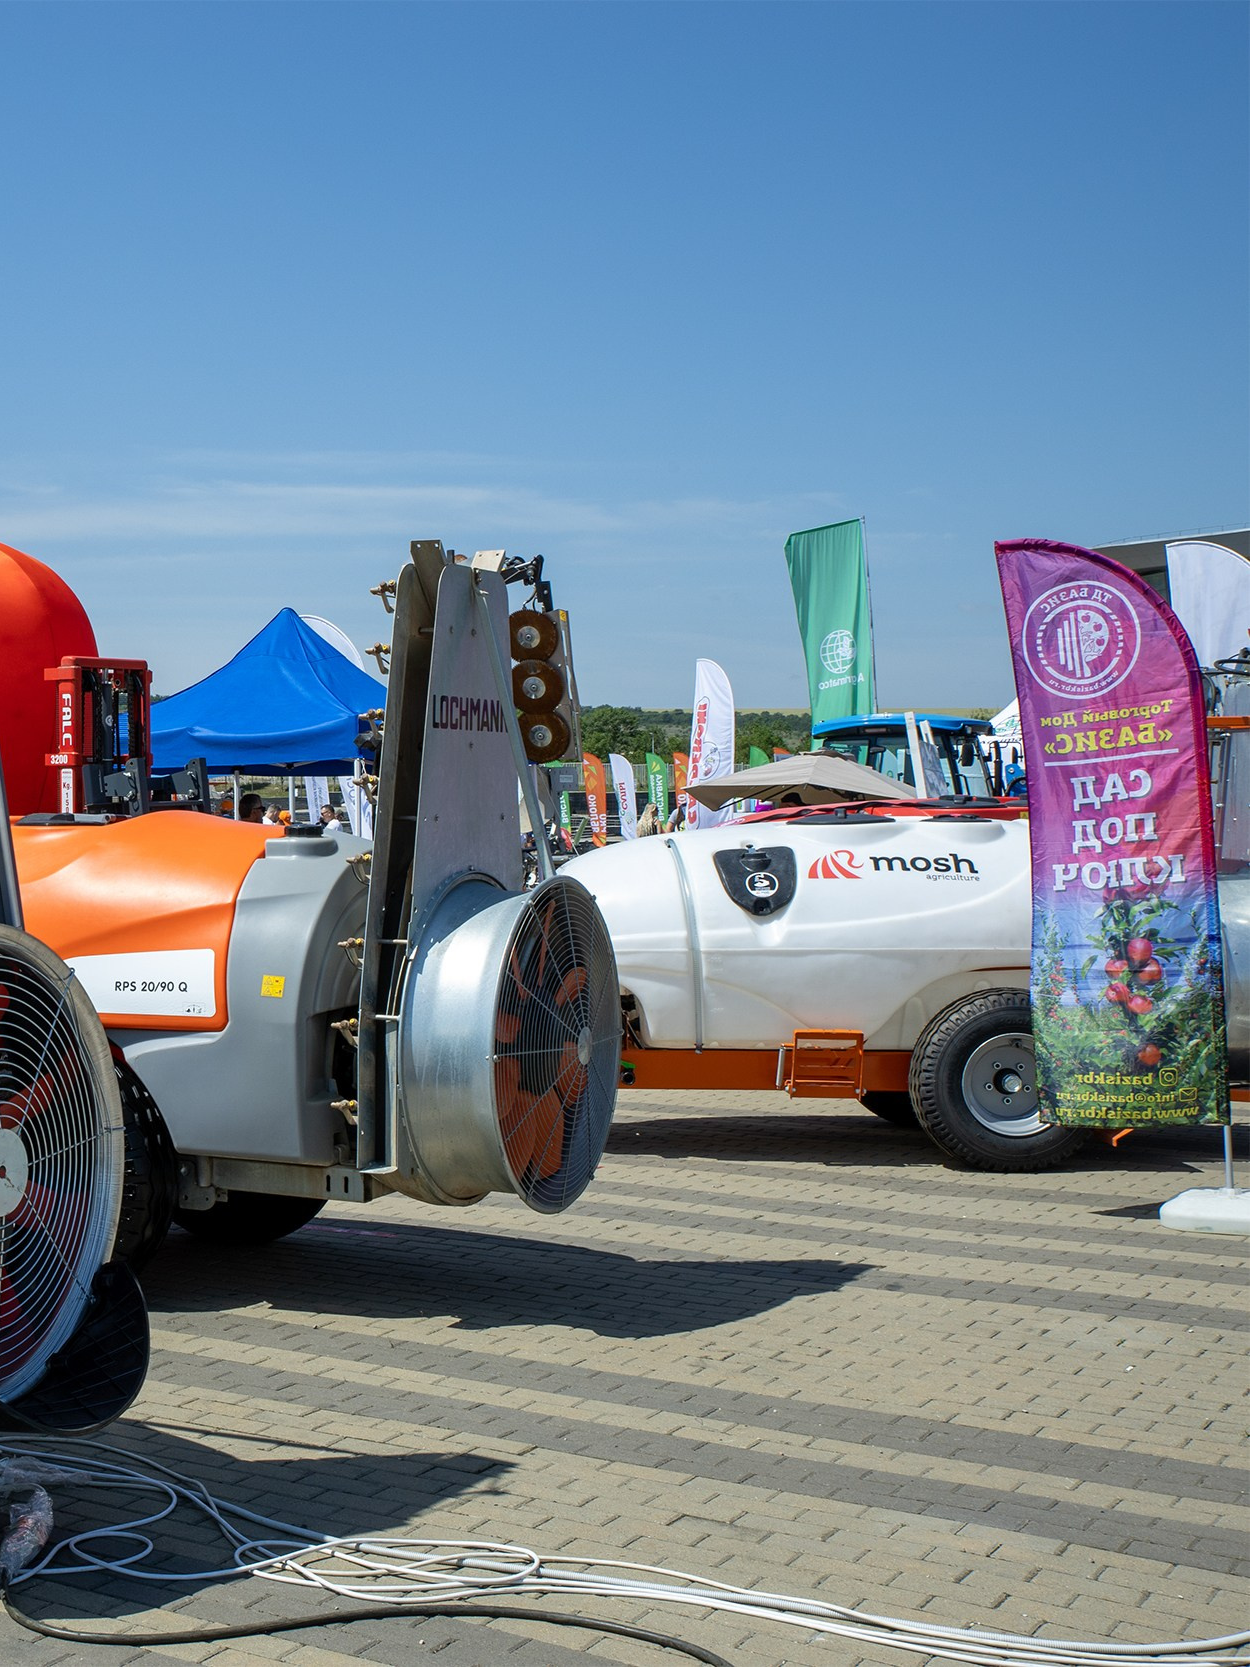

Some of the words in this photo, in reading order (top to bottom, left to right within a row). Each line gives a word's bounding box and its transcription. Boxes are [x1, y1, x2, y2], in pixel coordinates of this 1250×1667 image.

[62, 693, 73, 747] FALC
[50, 755, 68, 765] 3200
[869, 851, 978, 874] mosh
[925, 873, 981, 882] agriculture
[114, 980, 136, 992] RPS
[140, 980, 175, 994] 20/90
[177, 981, 189, 993] Q
